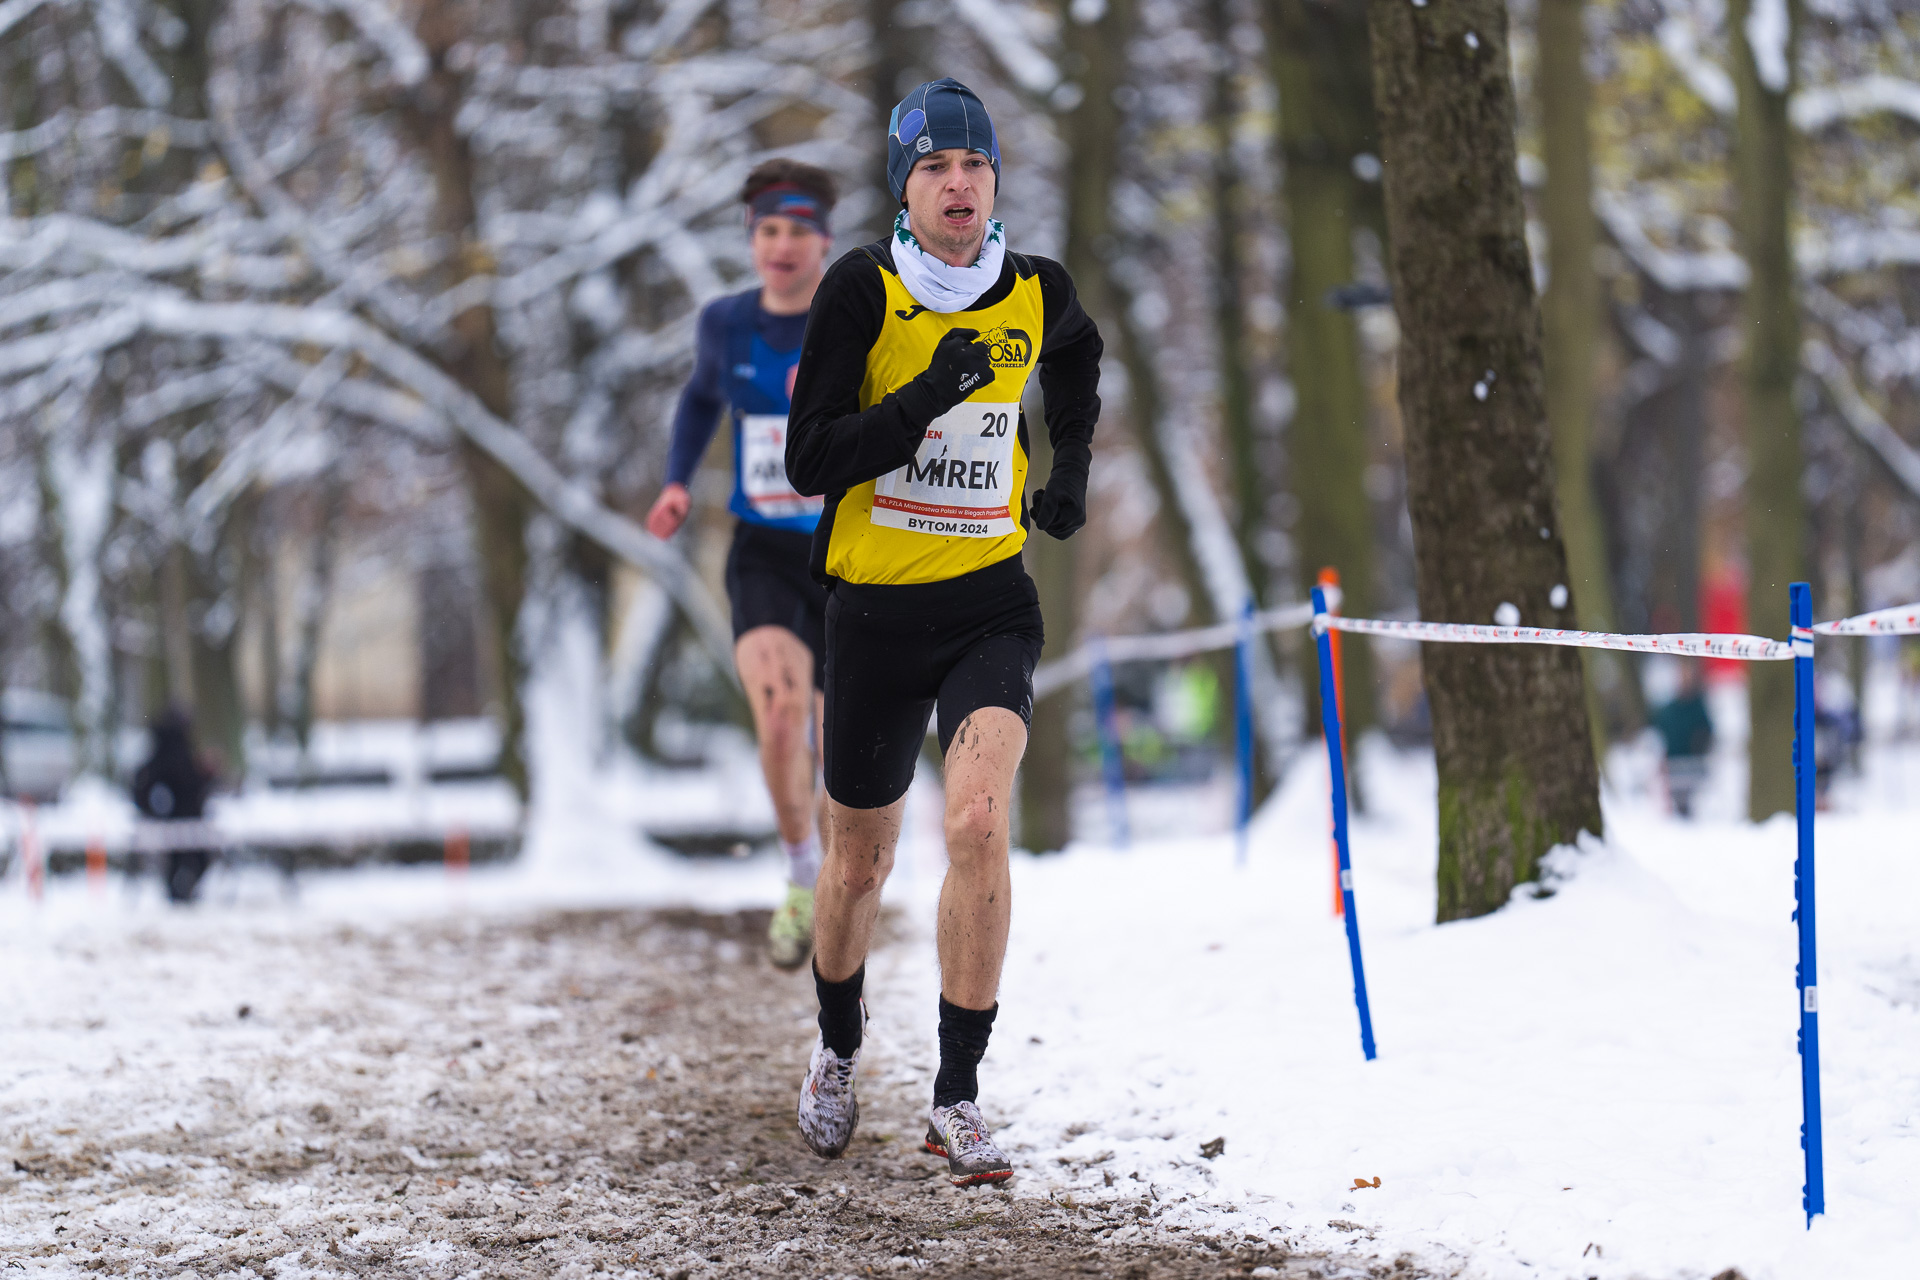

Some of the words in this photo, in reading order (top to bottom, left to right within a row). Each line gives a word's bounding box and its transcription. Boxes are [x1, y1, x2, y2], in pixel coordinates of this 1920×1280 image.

[989, 343, 1023, 362] OSA
[959, 372, 981, 392] CRIVIT
[980, 412, 1008, 437] 20
[906, 456, 999, 489] MIREK
[904, 503, 939, 513] Mistrzostwa
[964, 509, 985, 517] Biegach
[908, 518, 957, 532] BYTOM
[959, 523, 988, 534] 2024
